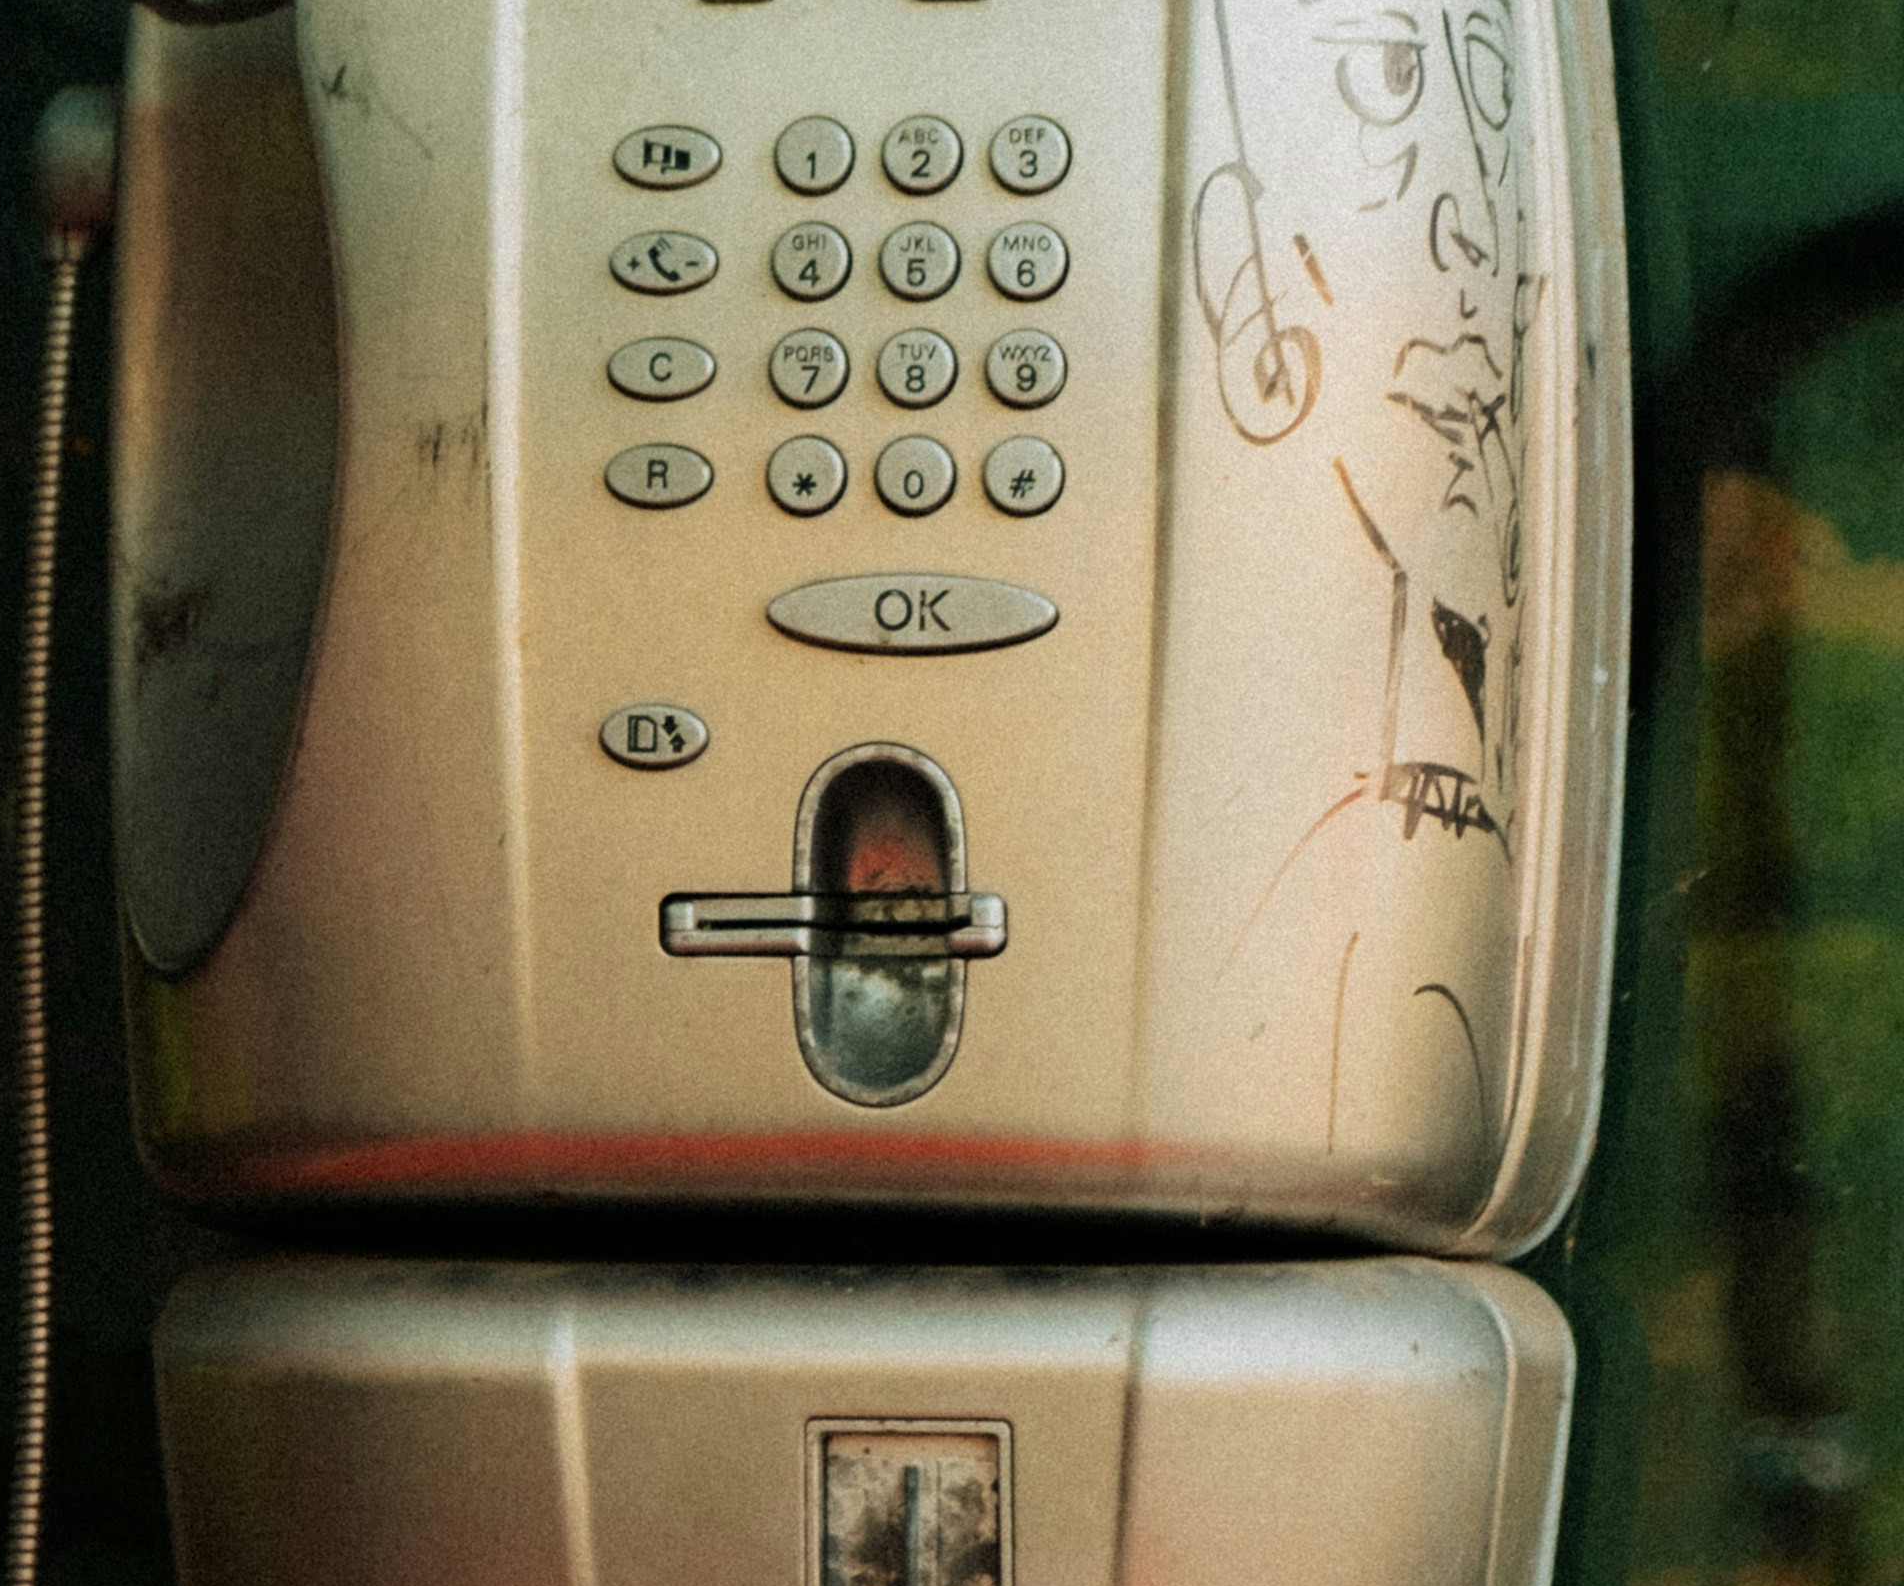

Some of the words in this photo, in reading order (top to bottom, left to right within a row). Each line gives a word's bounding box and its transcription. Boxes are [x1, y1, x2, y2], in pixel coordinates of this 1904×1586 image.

[898, 127, 940, 145] ABC
[1009, 127, 1046, 145] DEF
[805, 151, 817, 180] 1
[910, 150, 931, 179] 2
[1018, 149, 1038, 178] 3
[791, 235, 827, 253] GHI
[899, 235, 936, 253] JKL
[1003, 235, 1051, 253] MNO
[798, 258, 820, 287] 4
[906, 258, 926, 288] 5
[1016, 259, 1036, 288] 6
[783, 346, 835, 363] PQRS
[898, 343, 937, 360] TUV
[999, 346, 1051, 362] WXYZ
[649, 352, 672, 383] C
[801, 365, 820, 394] 7
[905, 365, 926, 393] 8
[1016, 364, 1037, 392] 9
[646, 459, 669, 489] R
[904, 470, 924, 499] 0
[874, 588, 951, 631] OK
